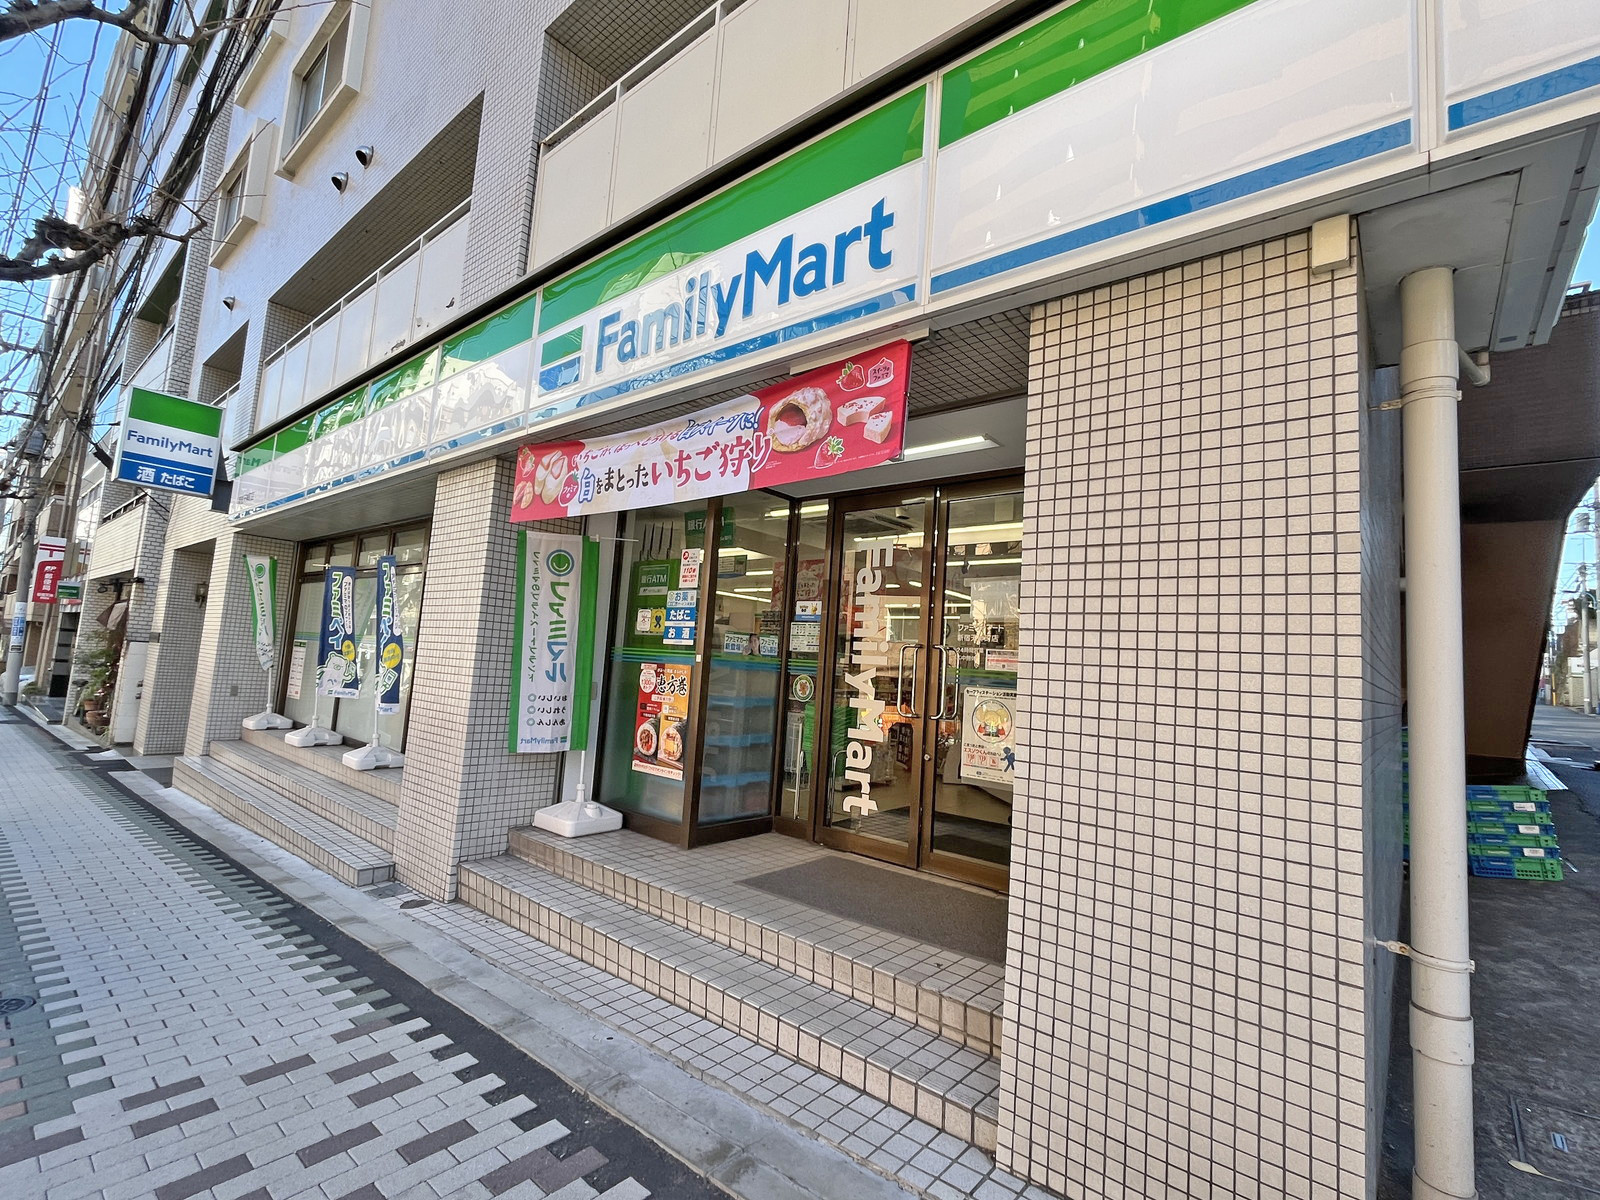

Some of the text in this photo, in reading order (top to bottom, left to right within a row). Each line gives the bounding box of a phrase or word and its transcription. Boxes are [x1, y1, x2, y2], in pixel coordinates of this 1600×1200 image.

[595, 197, 894, 373] FamilyMart
[127, 430, 213, 458] FamilyMart
[137, 466, 195, 489] 酒 たばこ
[329, 571, 345, 650] ファミペイ
[669, 609, 691, 620] たばこ
[656, 675, 688, 696] 恵方巻
[845, 538, 894, 816] FamilyMart
